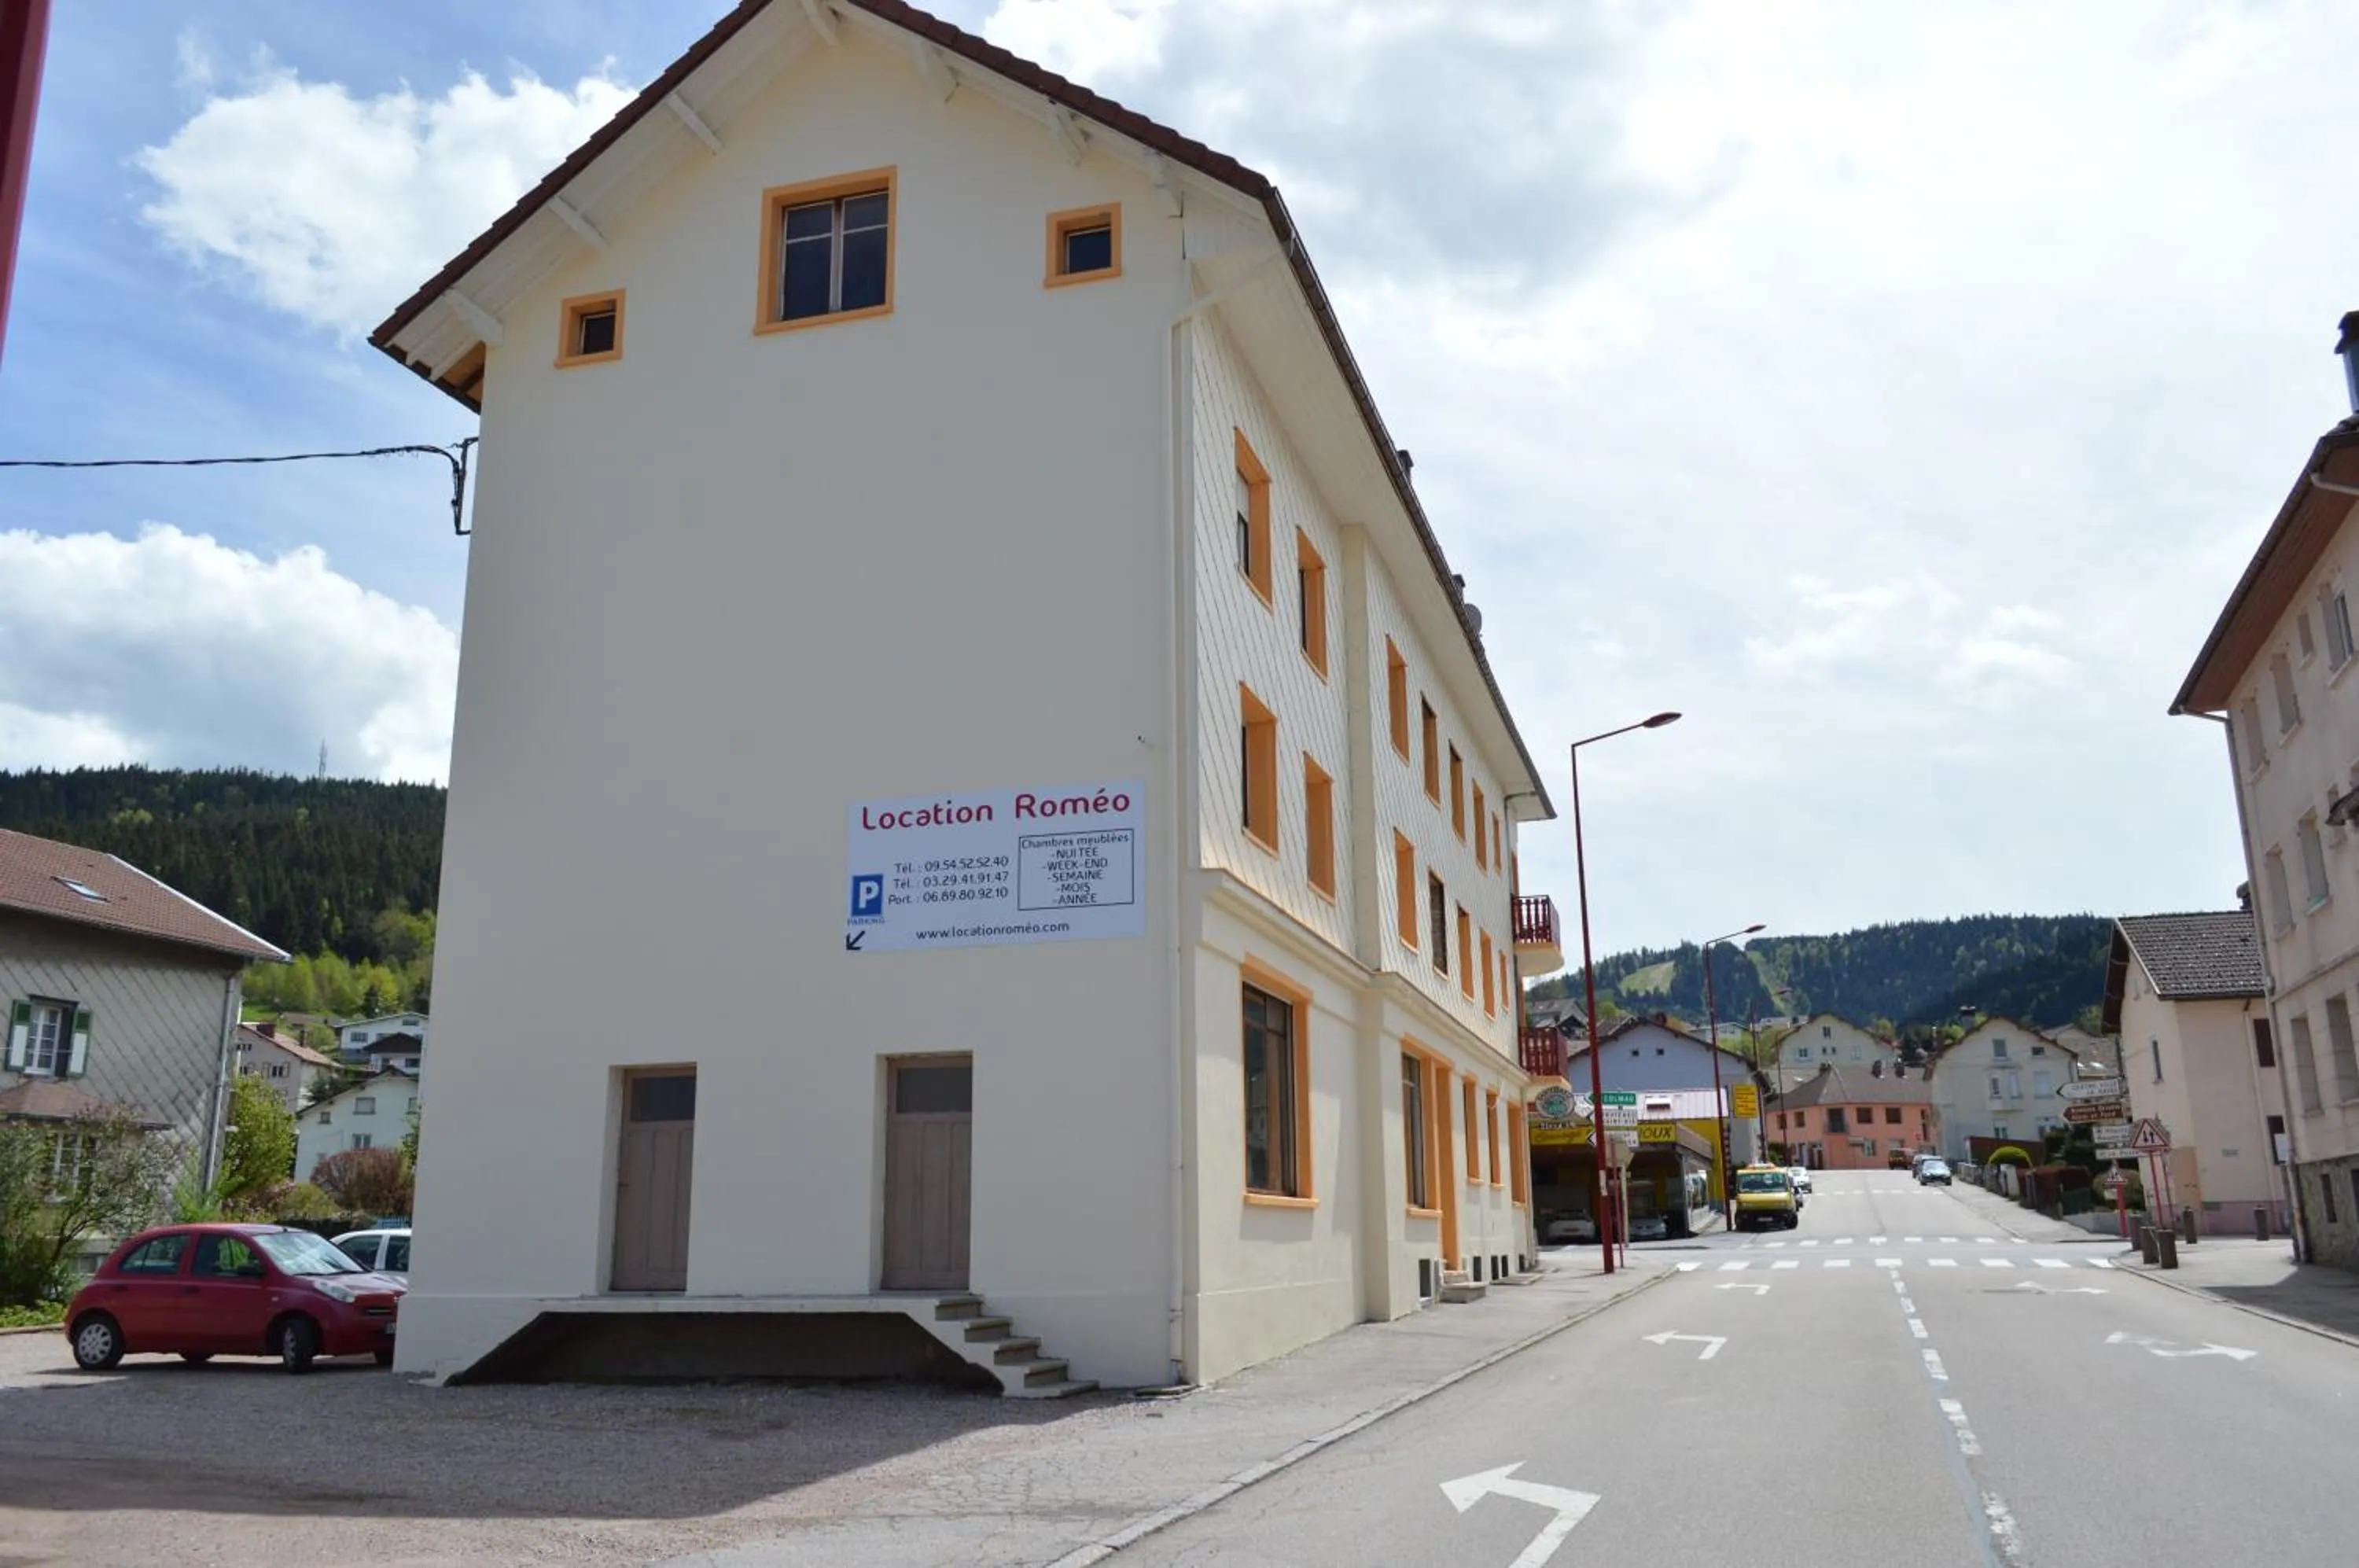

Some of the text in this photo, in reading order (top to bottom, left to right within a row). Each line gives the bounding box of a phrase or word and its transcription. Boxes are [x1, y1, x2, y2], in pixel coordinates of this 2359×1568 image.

[862, 788, 1130, 831] Location Roméo
[1021, 832, 1129, 849] Chambres meublées
[859, 881, 879, 909] P
